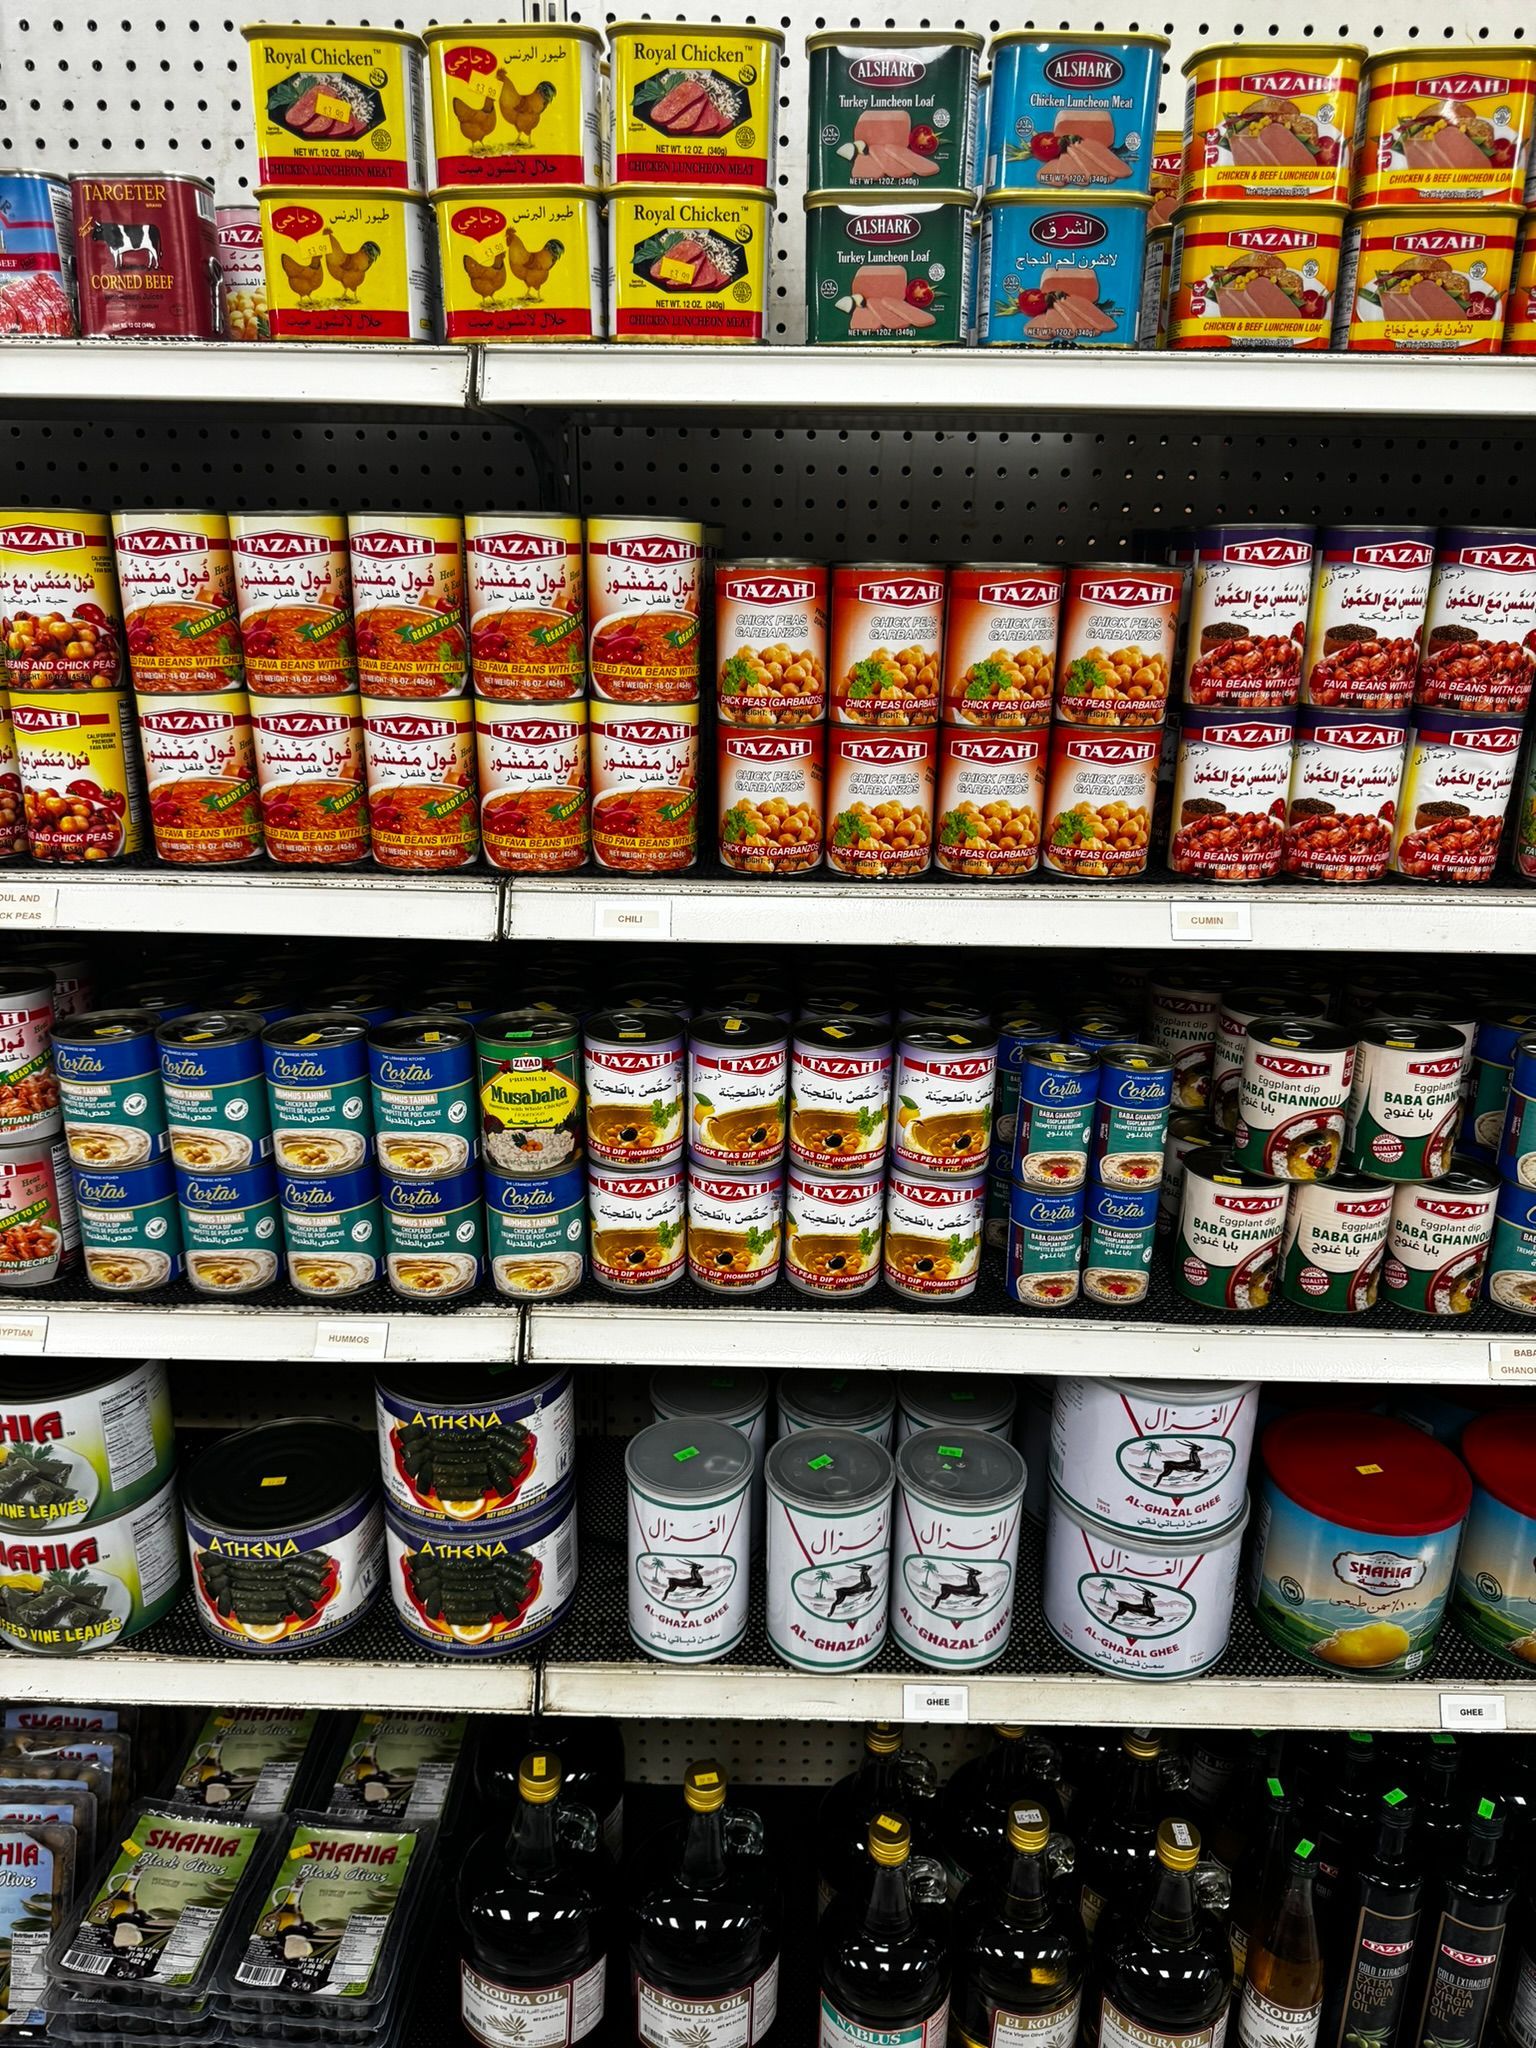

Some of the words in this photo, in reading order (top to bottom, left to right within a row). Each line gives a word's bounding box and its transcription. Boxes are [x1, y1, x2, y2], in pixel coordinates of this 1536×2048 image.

[265, 47, 306, 69] Royal
[504, 48, 538, 67] البرنس
[542, 48, 566, 65] طيور
[634, 43, 677, 66] Royal
[447, 52, 491, 74] دجاجي
[858, 61, 917, 79] ALSHARK
[1054, 61, 1113, 79] ALSHARK
[1250, 78, 1326, 91] TAZAH
[839, 95, 868, 110] Turkey
[871, 95, 912, 108] Luncheon
[914, 95, 935, 108] Loaf
[1031, 94, 1064, 107] Chicken
[1067, 95, 1109, 109] Luncheon
[1112, 96, 1133, 109] Meat
[656, 144, 670, 154] NET
[684, 145, 693, 154] 12
[708, 145, 728, 157] (340g)
[83, 184, 167, 201] TARGETER
[276, 208, 318, 232] دجاجي
[330, 208, 362, 224] البرنس
[365, 208, 390, 224] طيور
[512, 206, 546, 224] البرنس
[550, 208, 573, 223] طيور
[855, 218, 912, 236] ALSHARK
[1042, 220, 1092, 240] الشرق
[837, 250, 865, 266] Turkey
[868, 250, 908, 263] Luncheon
[910, 250, 930, 263] Loaf
[1016, 254, 1052, 270] الدجاج
[1056, 253, 1075, 273] لحم
[91, 275, 143, 290] CORNED
[145, 275, 174, 290] BEEF
[1203, 321, 1234, 332] CHICKEN
[1235, 322, 1243, 331] &
[1245, 322, 1263, 331] BEEF
[1264, 322, 1303, 332] LUNCHEON
[1304, 323, 1322, 333] LOAF
[121, 536, 198, 552] TAZAH
[354, 538, 425, 554] TAZAH
[617, 541, 691, 558] TAZAH
[870, 585, 939, 601] TAZAH
[1091, 585, 1167, 601] TAZAH
[736, 615, 773, 626] CHICK
[775, 615, 807, 626] PEAS
[1089, 616, 1125, 628] CHICK
[1128, 617, 1162, 628] PEAS
[735, 627, 808, 638] GARBANZOS
[1086, 629, 1162, 642] GARBANZOS
[32, 661, 54, 669] AND
[56, 660, 90, 669] CHICK
[93, 660, 116, 669] PEAS
[1201, 678, 1223, 689] FAVA
[1226, 679, 1262, 689] BEANS
[1265, 678, 1287, 689] WITH
[1323, 679, 1345, 690] FAVA
[1348, 680, 1385, 690] BEANS
[1388, 680, 1409, 690] WITH
[845, 698, 871, 710] CHICK
[873, 699, 898, 710] PEAS
[148, 715, 225, 730] TAZAH
[373, 721, 448, 736] TAZAH
[612, 724, 686, 739] TAZAH
[1325, 730, 1399, 744] TAZAH
[847, 743, 922, 759] TAZAH
[1075, 743, 1150, 759] TAZAH
[736, 770, 770, 781] CHICK
[773, 770, 804, 781] PEAS
[959, 772, 993, 783] CHICK
[995, 773, 1029, 784] PEAS
[735, 781, 805, 792] GARBANZOS
[957, 784, 1029, 795] GARBANZOS
[35, 833, 50, 842] AND
[52, 833, 83, 843] CHICK
[87, 832, 114, 842] PEAS
[620, 837, 642, 846] FAVA
[644, 837, 671, 846] BEANS
[1181, 850, 1201, 859] FAVA
[1203, 853, 1239, 863] BEANS
[1241, 852, 1264, 862] WITH
[1415, 851, 1441, 861] FAVA
[1443, 853, 1478, 864] BEANS
[15, 912, 42, 920] PEAS
[618, 915, 642, 923] CHILI
[1191, 916, 1224, 925] CUMIN
[57, 1054, 104, 1077] Cortas
[514, 1059, 540, 1067] ZIYAD
[1258, 1075, 1301, 1092] Eggplant
[1303, 1083, 1320, 1094] dip
[491, 1085, 567, 1105] Musabaha
[1268, 1088, 1341, 1108] GHANNOUJ
[1384, 1091, 1416, 1105] BABA
[718, 1150, 739, 1159] PEAS
[741, 1151, 755, 1159] DIP
[1372, 1144, 1403, 1152] QUALITY
[817, 1154, 830, 1162] DIP
[832, 1152, 868, 1162] (HOMMOS
[22, 1176, 40, 1187] Heat
[604, 1177, 671, 1195] TAZAH
[26, 1188, 32, 1196] &
[35, 1183, 49, 1192] Eat
[812, 1184, 875, 1200] TAZAH
[34, 1201, 47, 1211] EAT
[1420, 1218, 1462, 1233] Eggplant
[1464, 1222, 1481, 1233] dip
[1300, 1277, 1329, 1286] QUALITY
[328, 1335, 369, 1344] HUMMOS
[411, 1411, 503, 1432] ATHENA
[30, 1498, 89, 1520] LEAVES
[1125, 1495, 1194, 1517] AL-GHAZAL
[1194, 1495, 1221, 1515] GHEE
[209, 1536, 300, 1559] ATHENA
[421, 1541, 509, 1560] ATHENA
[1349, 1561, 1412, 1579] SHAHIA
[31, 1629, 61, 1643] VINE
[66, 1617, 122, 1642] LEAVES
[927, 1698, 950, 1707] GHEE
[1460, 1707, 1484, 1717] GHEE
[145, 1829, 241, 1858] SHAHIA
[304, 1840, 399, 1866] SHAHIA
[138, 1852, 181, 1868] Black
[183, 1858, 228, 1876] Olives
[465, 1968, 478, 1988] EL
[480, 1982, 530, 2006] KOURA
[536, 1990, 563, 2004] OIL
[1357, 1975, 1392, 1988] EXTRA
[1356, 1982, 1394, 1997] VIRGIN
[642, 1986, 659, 2003] EL
[661, 1997, 716, 2016] KOURA
[719, 1998, 745, 2013] OIL
[1352, 1999, 1370, 2014] OIL
[1354, 1991, 1387, 2007] OLIVE
[1005, 2017, 1023, 2028] EL
[1028, 2010, 1070, 2029] KOURA
[1260, 2002, 1312, 2024] KOURA
[836, 2015, 901, 2045] NABLUS
